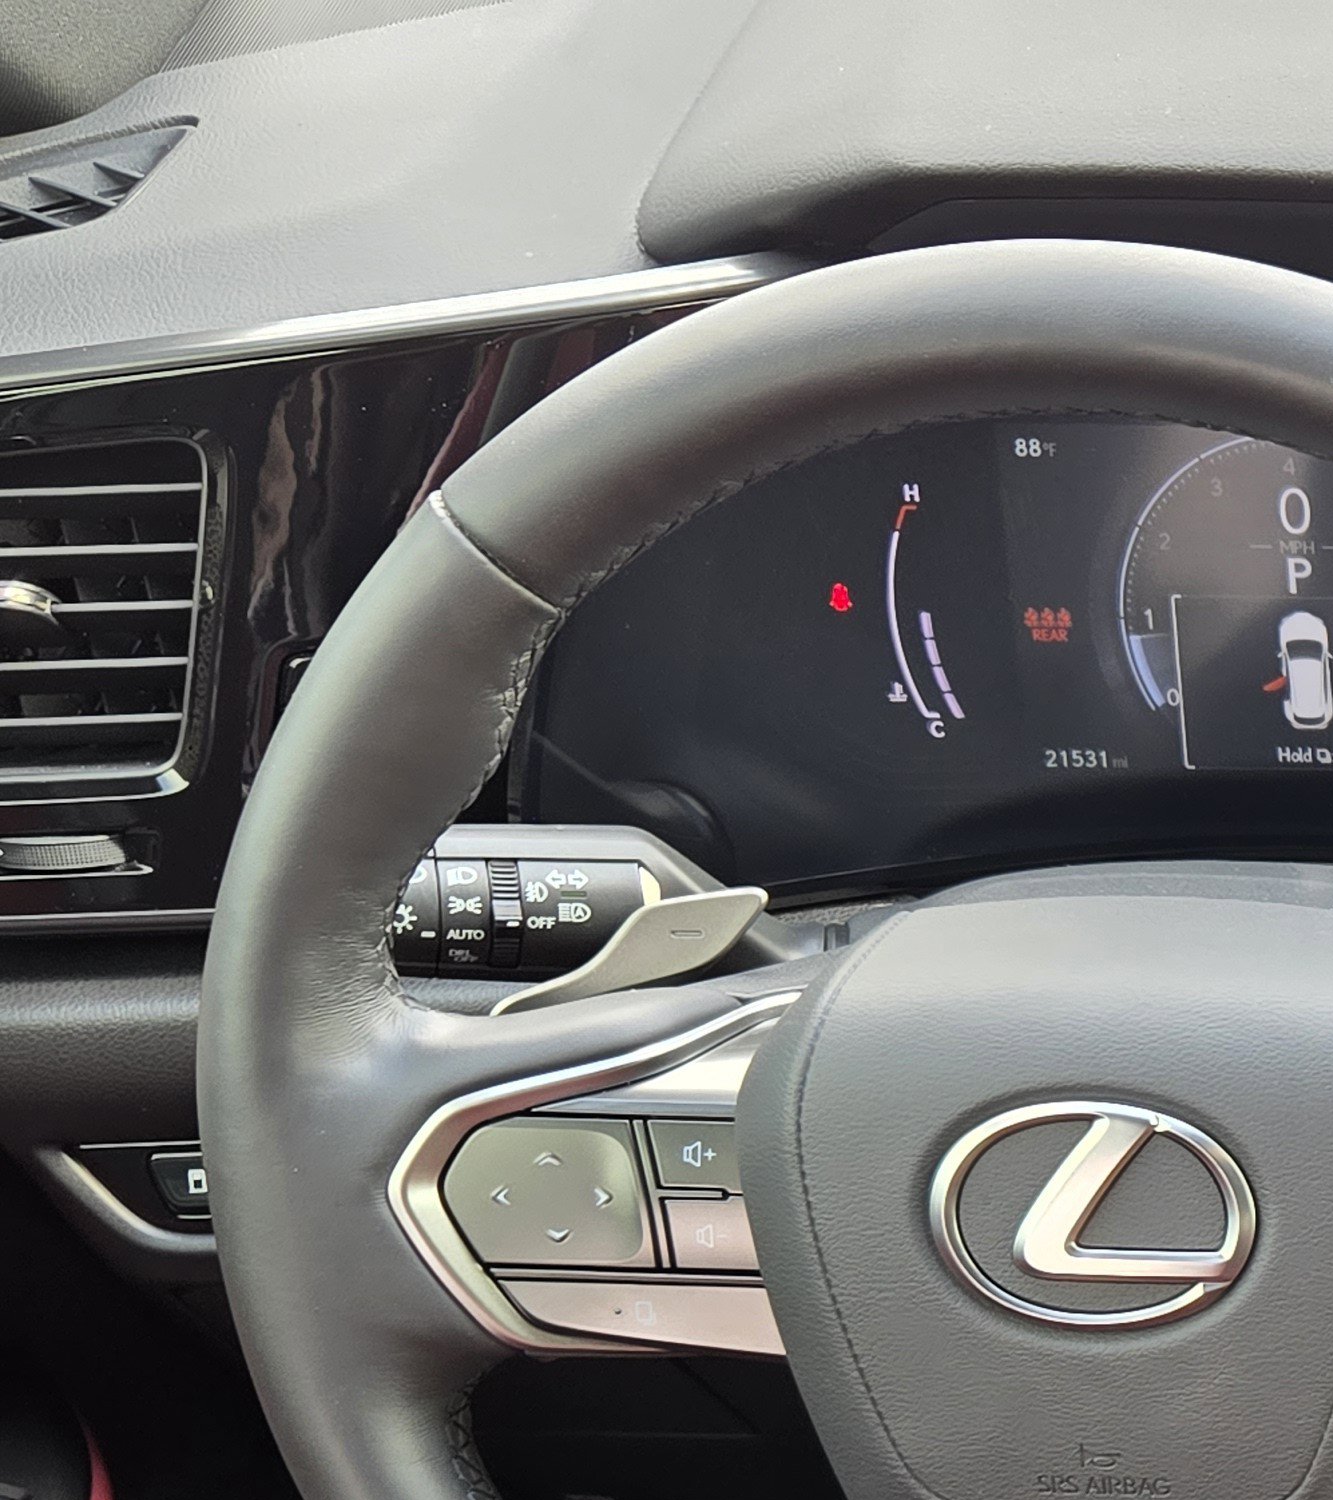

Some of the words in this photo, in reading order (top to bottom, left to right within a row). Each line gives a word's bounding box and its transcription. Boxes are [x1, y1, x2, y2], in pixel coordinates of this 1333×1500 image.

[1283, 458, 1296, 475] 4
[903, 483, 920, 502] H
[1210, 480, 1223, 497] 3
[1279, 487, 1311, 534] 0
[1159, 532, 1171, 550] 2
[1279, 540, 1316, 555] MPH
[1286, 557, 1312, 594] P
[1143, 608, 1154, 630] 1
[1032, 628, 1069, 642] REAR
[1166, 688, 1180, 706] 0
[928, 720, 946, 738] C
[1045, 750, 1108, 768] 21531
[1278, 747, 1313, 764] Hold
[527, 916, 557, 929] OFF
[446, 929, 485, 940] AUTO
[1037, 1474, 1080, 1495] SRS
[1085, 1475, 1172, 1497] AIRBAG
